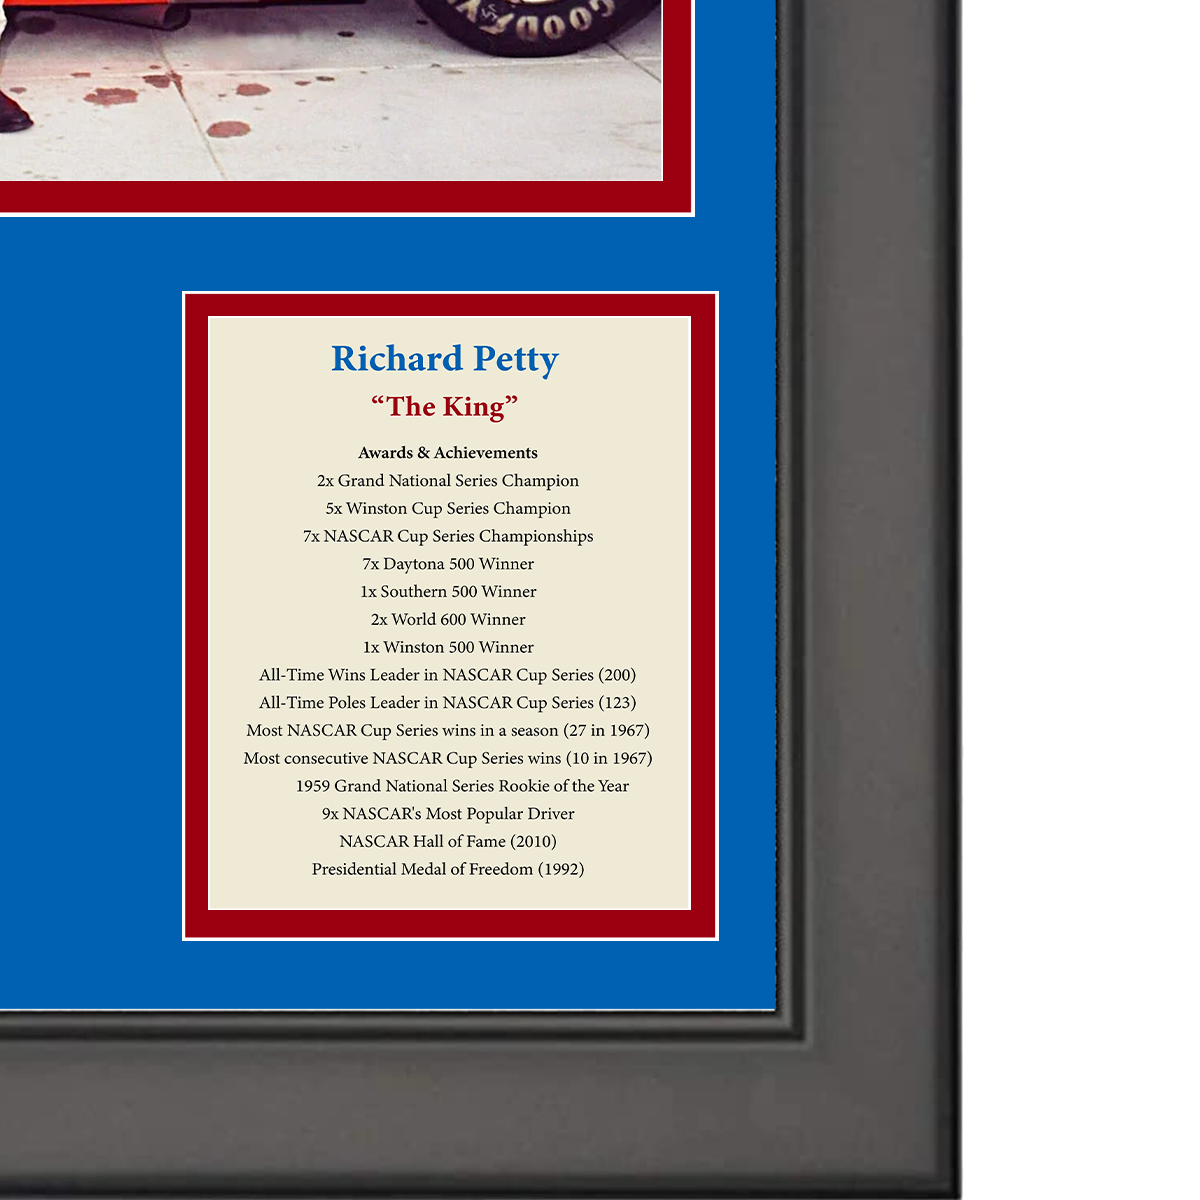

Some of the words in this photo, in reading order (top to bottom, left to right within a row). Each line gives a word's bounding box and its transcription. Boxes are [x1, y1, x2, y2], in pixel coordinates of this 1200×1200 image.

[331, 343, 464, 372] Richard
[472, 345, 560, 381] Petty
[371, 394, 436, 417] “The
[442, 394, 518, 424] King”
[357, 445, 414, 460] Awards
[417, 445, 431, 460] &
[433, 445, 539, 460] Achievements
[317, 474, 335, 487] 2x
[337, 472, 385, 488] Grand
[388, 473, 452, 488] National
[455, 473, 498, 488] Series
[501, 473, 580, 492] Champion
[325, 502, 343, 515] 5x
[345, 501, 408, 515] Winston
[411, 501, 443, 519] Cup
[446, 501, 490, 515] Series
[493, 500, 572, 519] Champion
[303, 529, 321, 543] 7x
[323, 528, 395, 543] NASCAR
[397, 528, 429, 547] Cup
[432, 528, 475, 543] Series
[479, 528, 594, 547] Championships
[362, 557, 380, 571] 7x
[383, 556, 446, 575] Daytona
[449, 557, 475, 571] 500
[478, 556, 535, 571] Winner
[360, 585, 378, 598] 1x
[380, 583, 448, 599] Southern
[451, 584, 478, 599] 500
[480, 584, 538, 598] Winner
[370, 612, 389, 626] 2x
[390, 611, 437, 626] World
[440, 612, 467, 626] 600
[469, 612, 527, 626] Winner
[363, 641, 380, 654] 1x
[382, 640, 445, 654] Winston
[448, 640, 475, 654] 500
[478, 640, 535, 654] Winner
[258, 667, 325, 682] All-Time
[327, 667, 366, 682] Wins
[370, 667, 421, 682] Leader
[423, 668, 439, 682] in
[442, 667, 514, 682] NASCAR
[516, 667, 548, 686] Cup
[551, 667, 595, 682] Series
[598, 666, 637, 685] (200)
[258, 694, 325, 709] All-Time
[328, 694, 367, 710] Poles
[370, 694, 421, 709] Leader
[423, 695, 439, 709] in
[442, 695, 514, 710] NASCAR
[516, 695, 548, 714] Cup
[551, 695, 595, 710] Series
[598, 694, 637, 712] (123)
[246, 723, 283, 737] Most
[286, 723, 358, 737] NASCAR
[360, 723, 392, 741] Cup
[395, 723, 439, 737] Series
[441, 723, 477, 737] wins
[480, 723, 495, 737] in
[498, 727, 507, 737] a
[511, 726, 559, 737] season
[563, 722, 587, 740] (27
[590, 723, 606, 737] in
[610, 722, 650, 740] 1967)
[243, 751, 281, 765] Most
[283, 751, 369, 765] consecutive
[372, 751, 444, 765] NASCAR
[446, 751, 478, 769] Cup
[481, 751, 524, 765] Series
[527, 751, 562, 765] wins
[566, 750, 590, 768] (10
[593, 751, 608, 765] in
[613, 750, 653, 768] 1967)
[296, 779, 331, 793] 1959
[334, 778, 382, 793] Grand
[385, 778, 448, 793] National
[451, 778, 495, 793] Series
[498, 778, 550, 793] Rookie
[553, 778, 571, 793] of
[571, 778, 595, 793] the
[597, 779, 630, 793] Year
[321, 807, 340, 821] 9x
[342, 805, 422, 821] NASCAR's
[425, 806, 463, 821] Most
[466, 806, 524, 825] Popular
[527, 806, 576, 821] Driver
[339, 834, 410, 849] NASCAR
[413, 833, 444, 848] Hall
[447, 833, 465, 848] of
[466, 834, 507, 848] Fame
[510, 833, 557, 851] (2010)
[311, 861, 397, 876] Presidential
[400, 861, 447, 876] Medal
[450, 861, 465, 877] of
[469, 861, 535, 877] Freedom
[537, 861, 586, 880] (1992)
